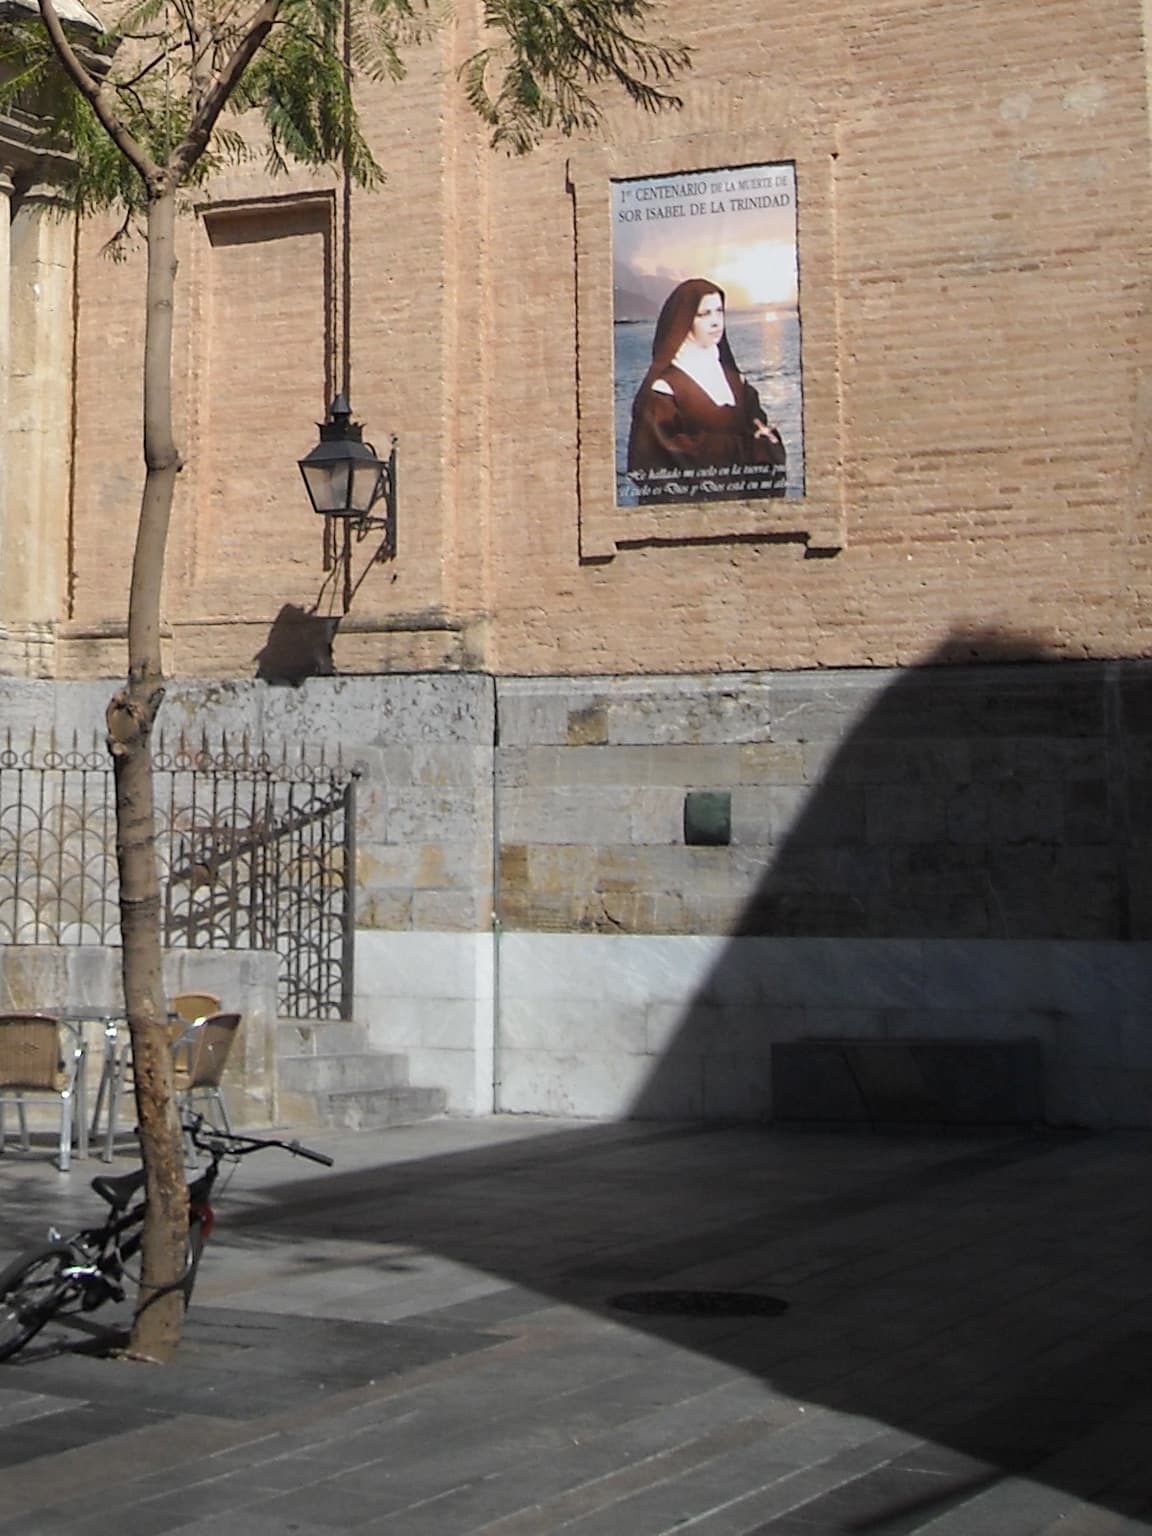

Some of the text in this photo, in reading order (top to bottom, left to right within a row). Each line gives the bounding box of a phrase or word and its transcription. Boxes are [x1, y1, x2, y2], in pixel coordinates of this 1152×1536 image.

[635, 182, 707, 202] CENTENARIO
[710, 182, 725, 194] DE
[725, 181, 736, 193] LA
[738, 177, 773, 192] MUERTE
[775, 175, 788, 187] DE
[618, 194, 790, 223] SOR ISABEL DE LA TRINIDAD
